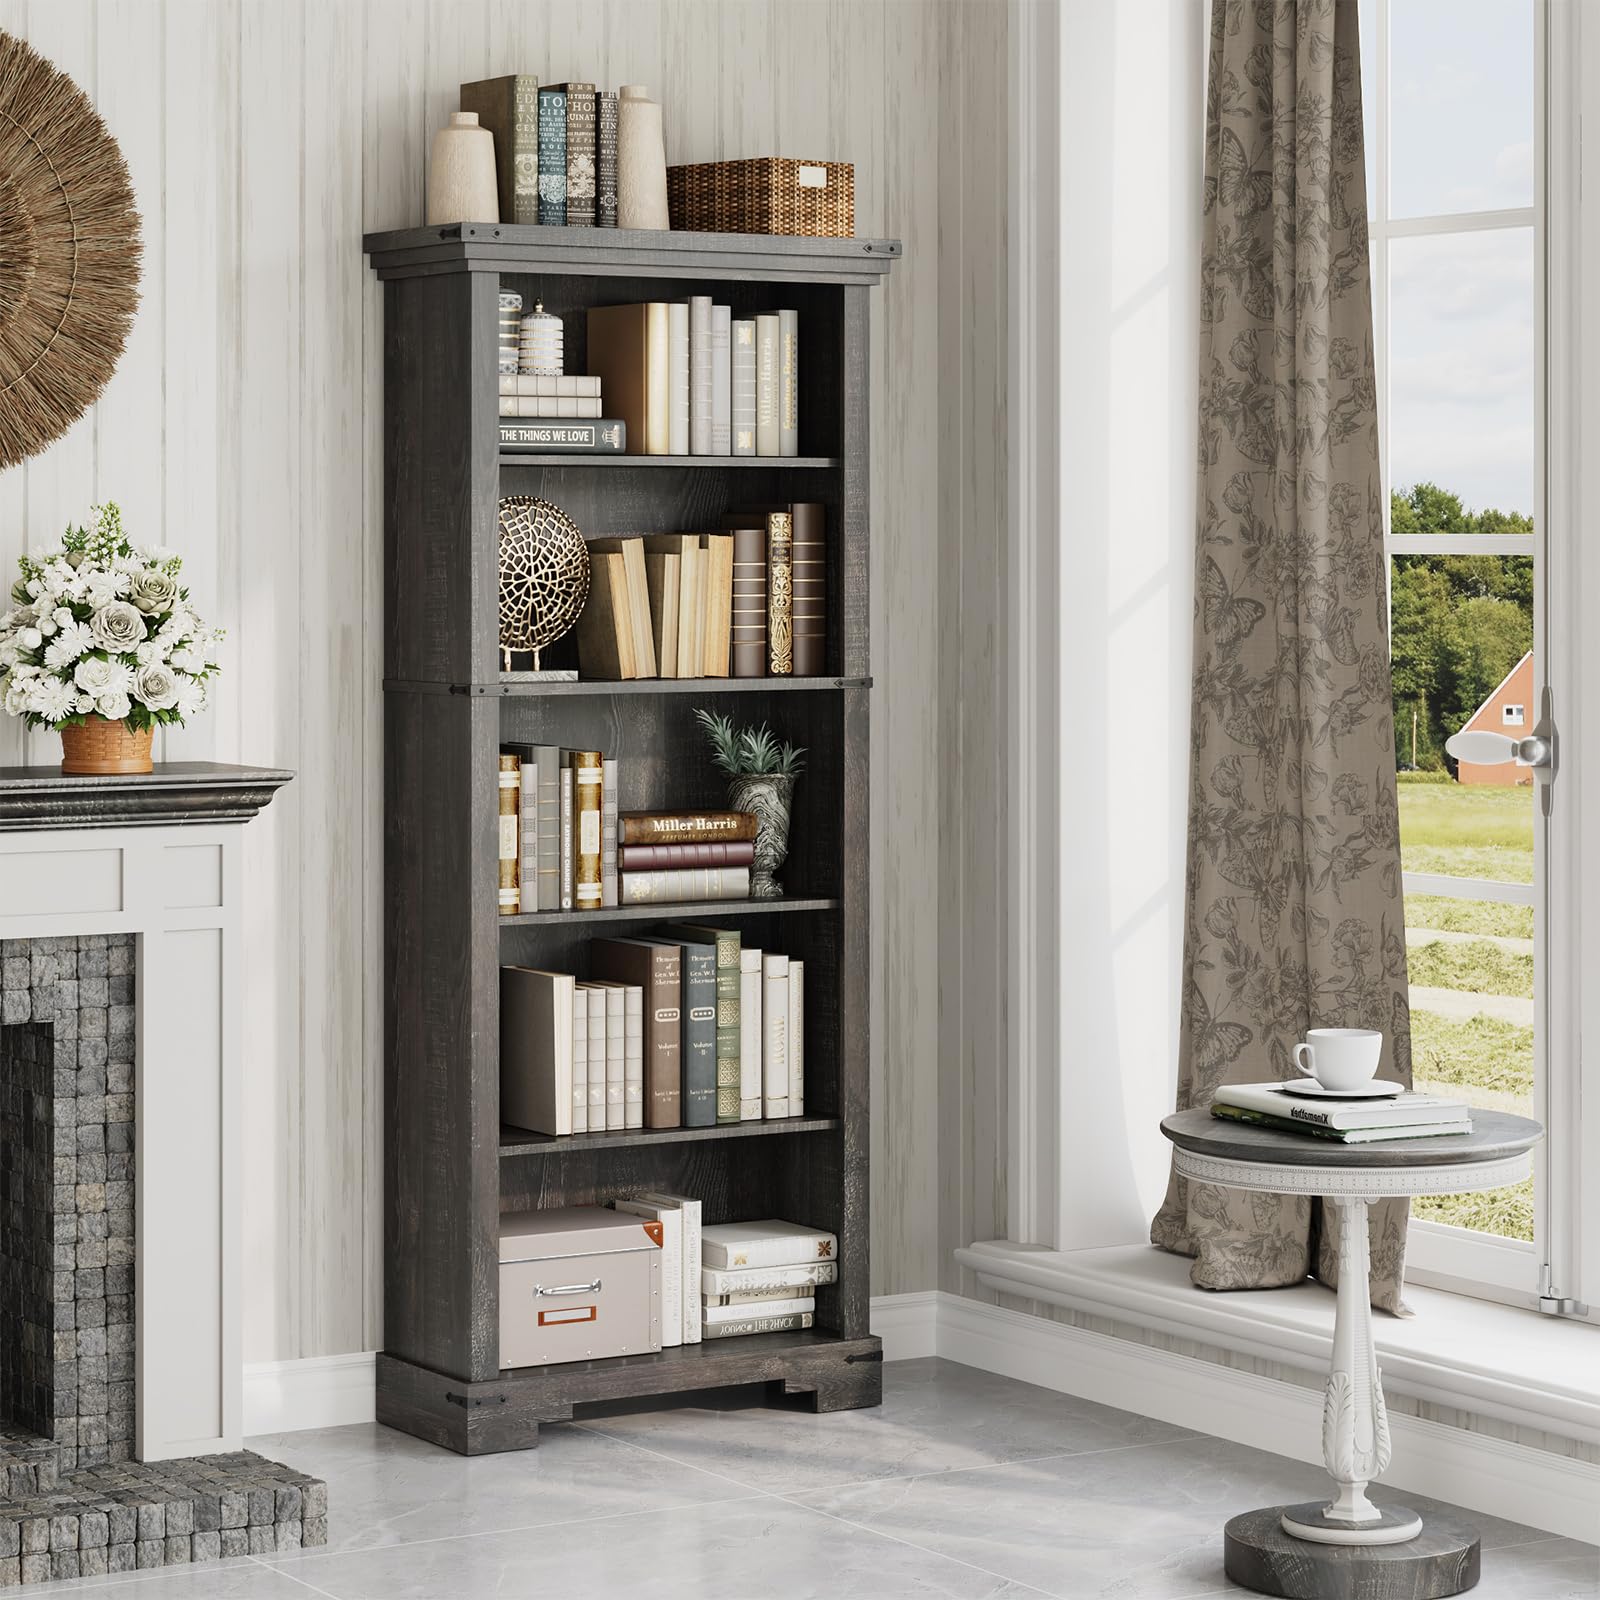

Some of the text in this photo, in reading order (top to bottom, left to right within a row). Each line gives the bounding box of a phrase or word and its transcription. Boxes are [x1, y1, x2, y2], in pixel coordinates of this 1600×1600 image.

[500, 430, 589, 442] THE THINGS WE LOVE
[653, 817, 738, 832] Miller Harris
